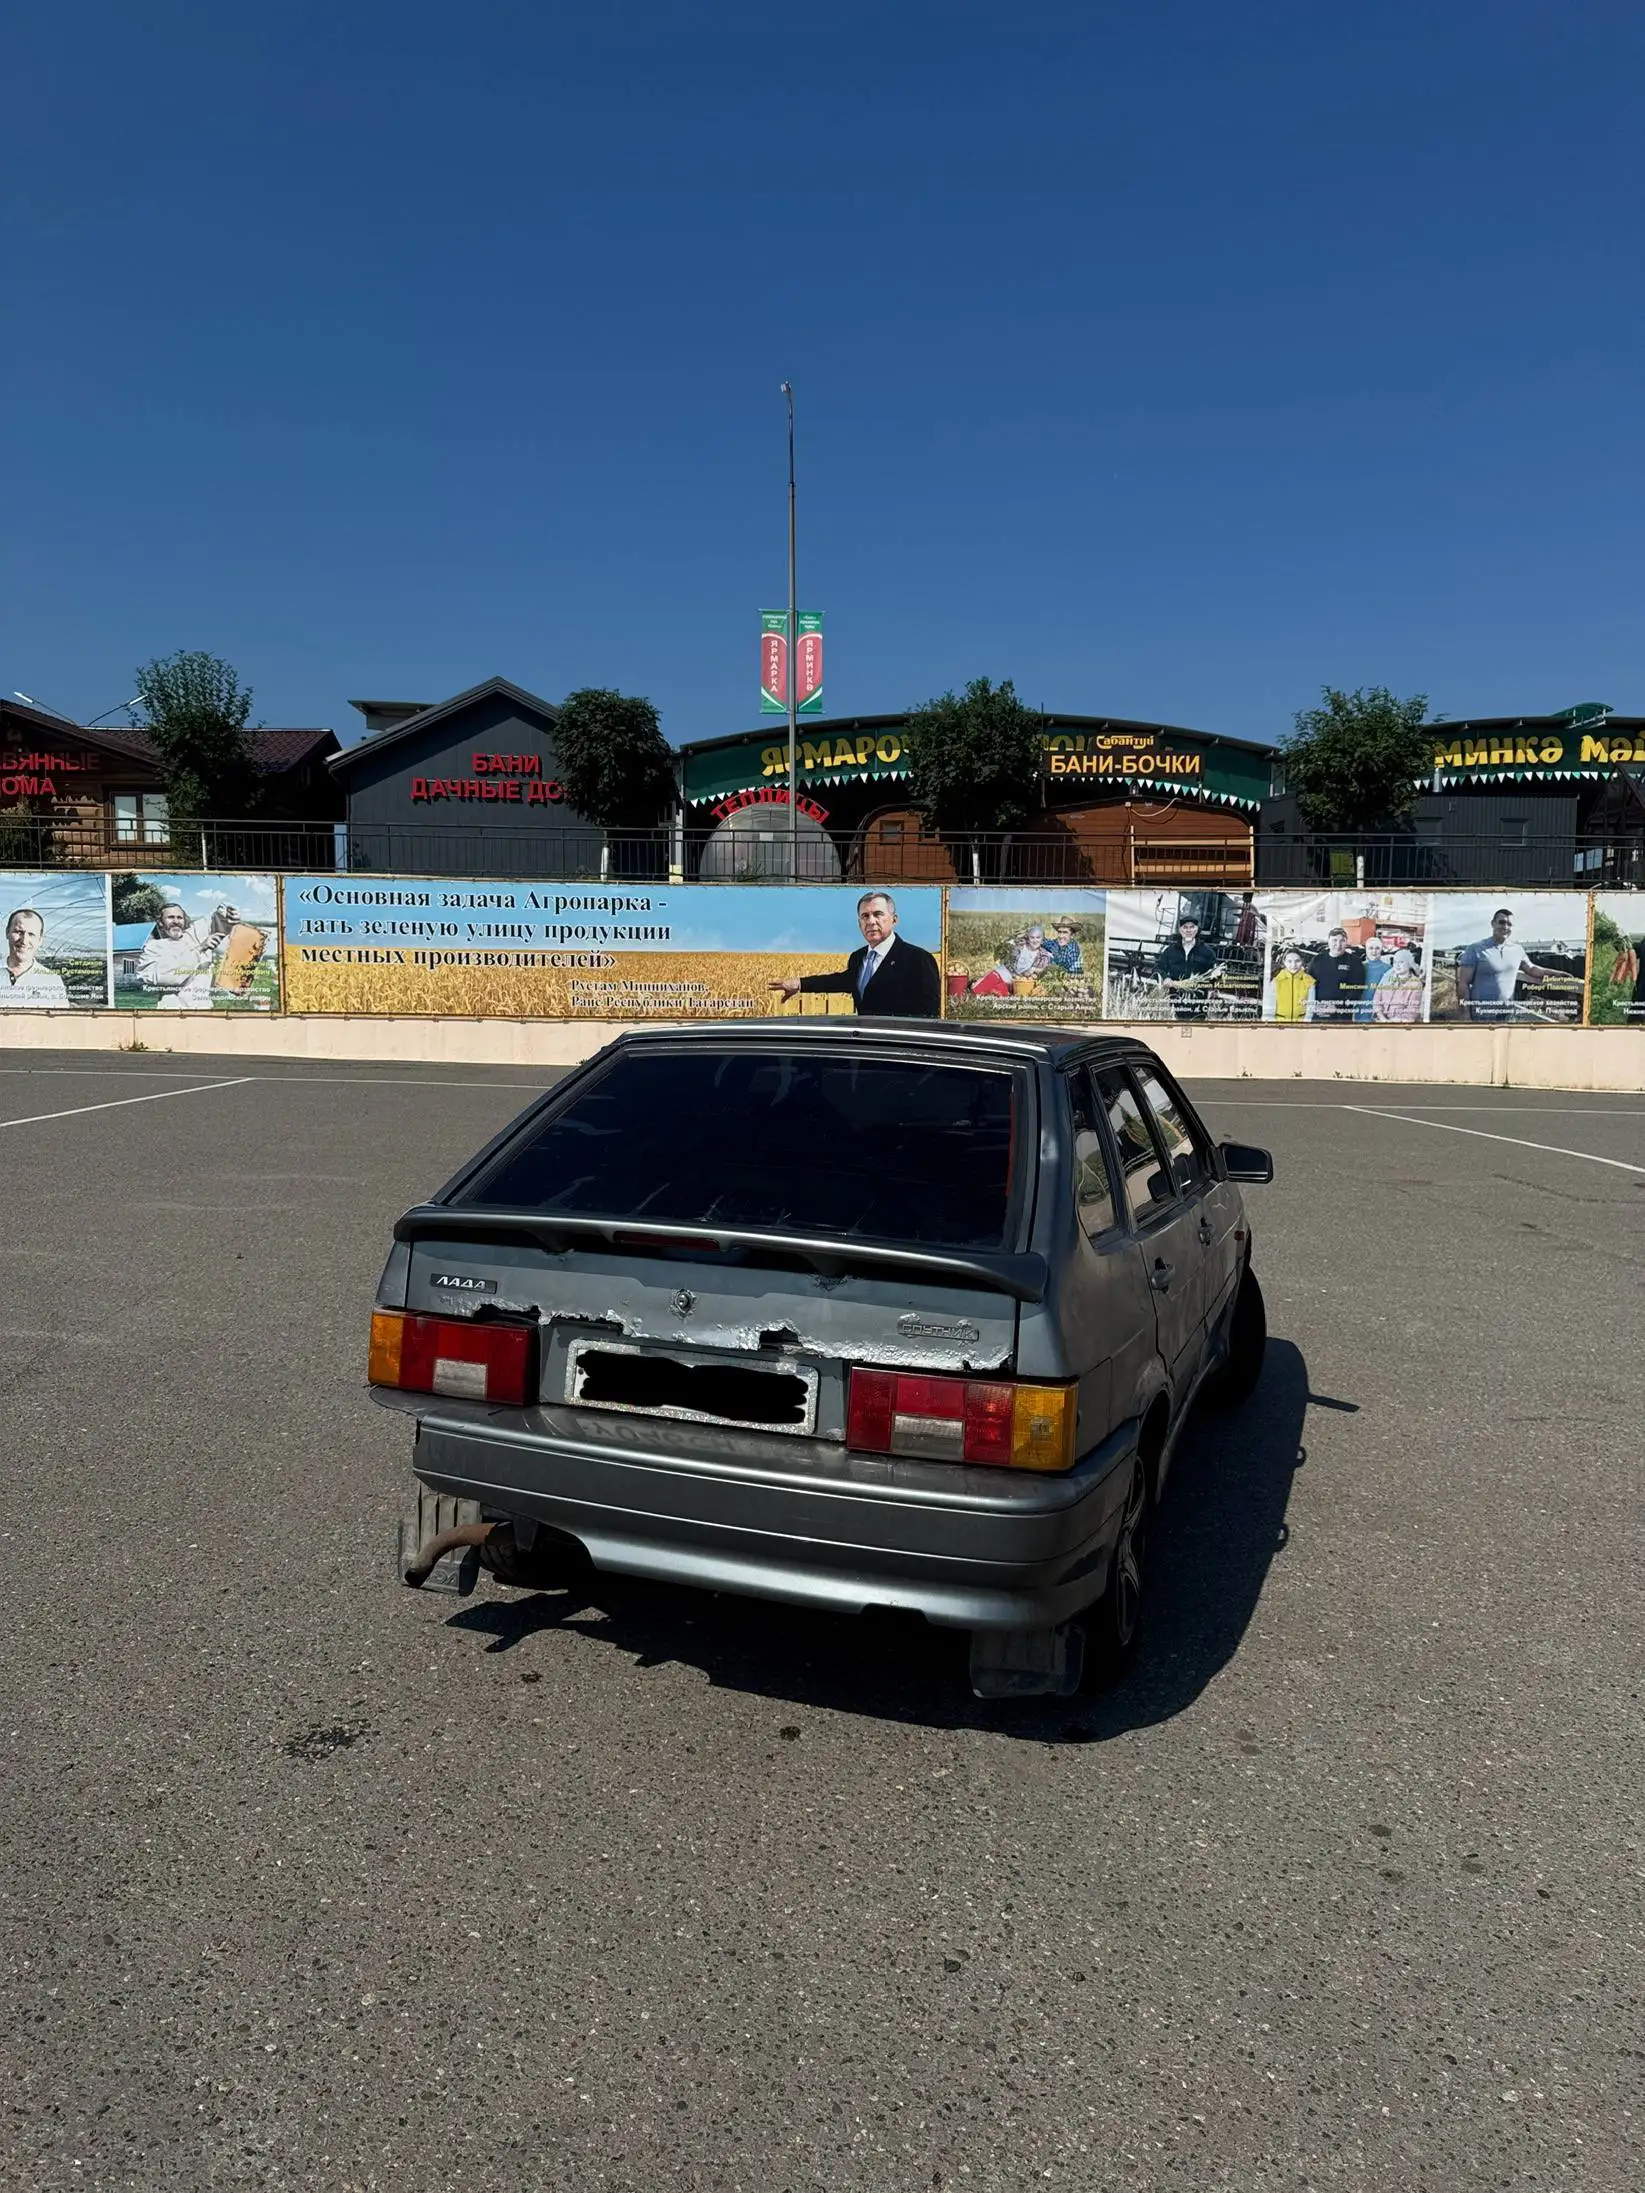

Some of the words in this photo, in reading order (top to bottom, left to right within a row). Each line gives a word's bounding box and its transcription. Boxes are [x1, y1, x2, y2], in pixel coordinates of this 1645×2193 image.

[770, 640, 779, 692] ЯРМАРКА
[0, 752, 100, 770] ВЯННЫЕ
[761, 735, 909, 777] ЯРМАРО
[1434, 736, 1563, 768] МИНКӘ
[472, 753, 539, 773] БАНИ
[1051, 755, 1200, 774] БАНИ-БОЧКИ
[1, 775, 57, 795] ОМА
[410, 777, 521, 800] ДАЧНЫЕ
[528, 780, 568, 803] ДО
[711, 788, 830, 824] ТЕПЛИЦЫ
[299, 885, 430, 907] «Основная
[438, 891, 515, 909] задача
[524, 891, 651, 915] Агропарка
[300, 918, 353, 934] дать
[361, 920, 458, 940] зеленую
[466, 922, 536, 943] улицу
[545, 925, 670, 944] продукции
[301, 948, 405, 964] местных
[414, 950, 616, 970] производителей»
[571, 980, 616, 992] Рустам
[621, 980, 709, 993] Минниханов,
[571, 996, 601, 1008] Раис
[606, 996, 683, 1009] Республики
[689, 997, 754, 1010] Татарстан
[1612, 1000, 1645, 1008] Крестьянс
[436, 1275, 486, 1290] ЛАДА
